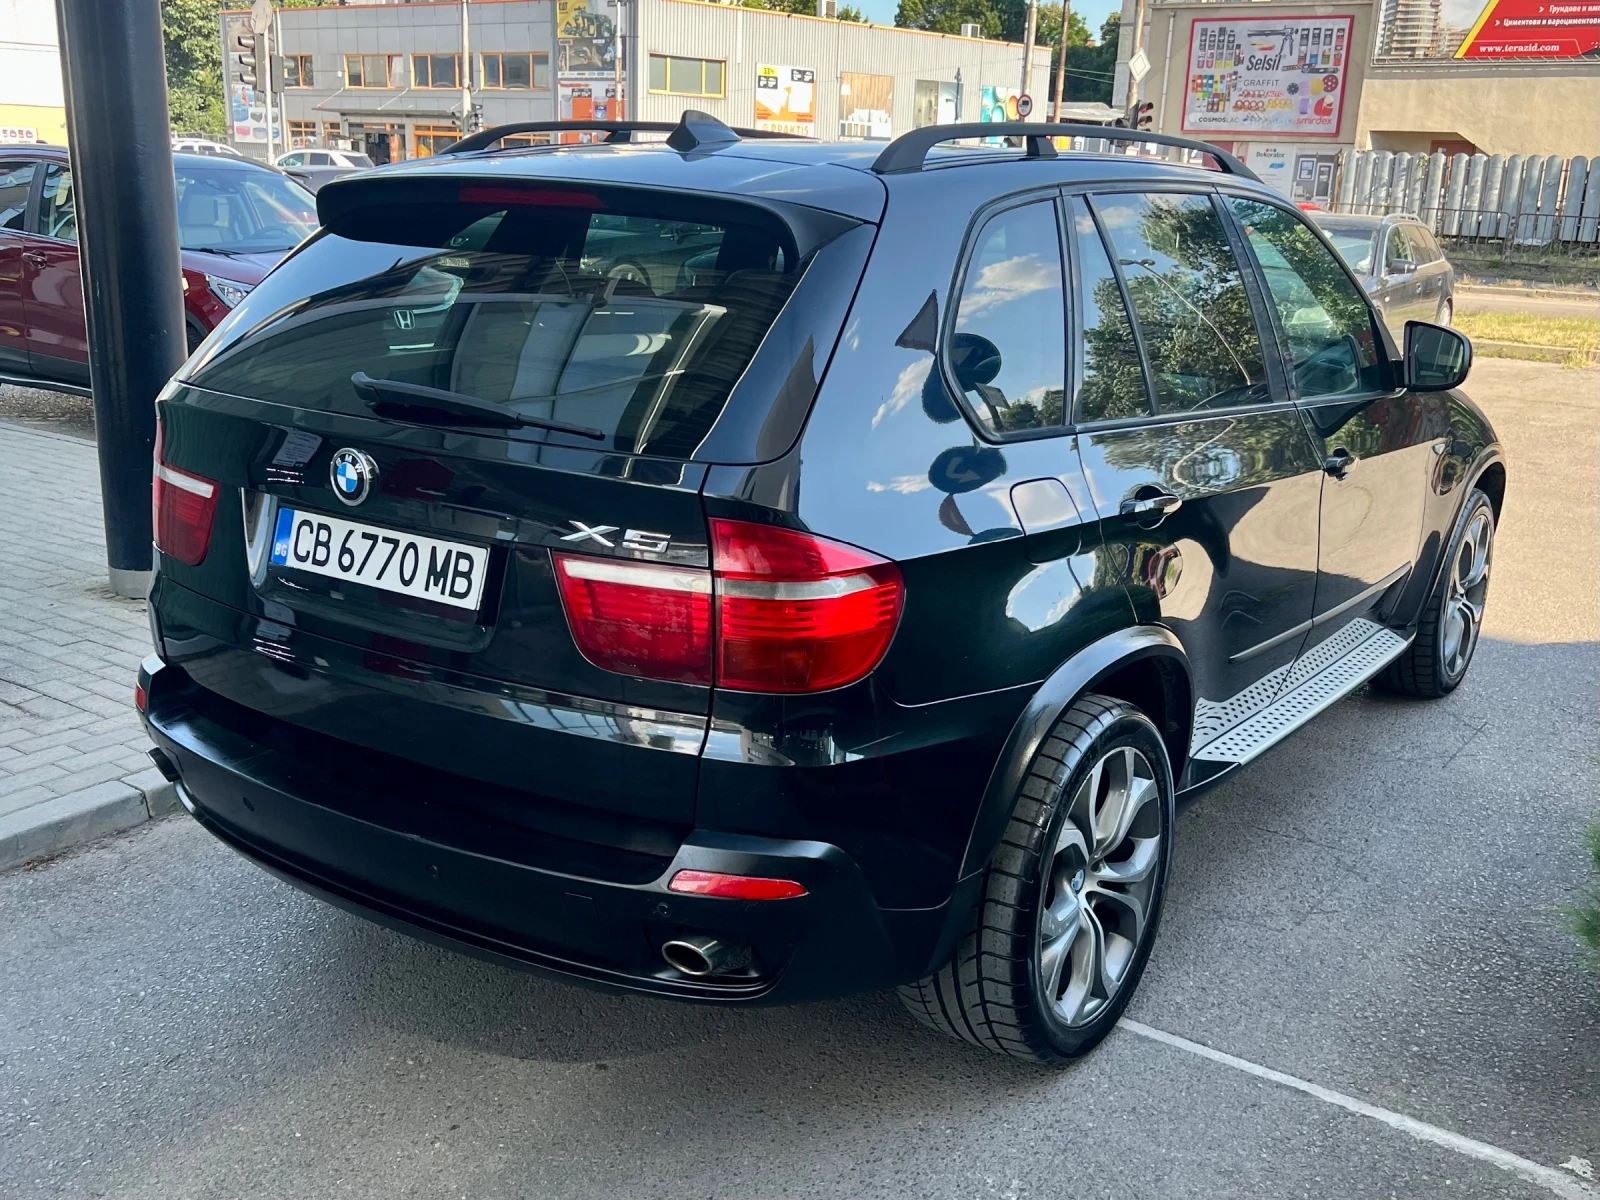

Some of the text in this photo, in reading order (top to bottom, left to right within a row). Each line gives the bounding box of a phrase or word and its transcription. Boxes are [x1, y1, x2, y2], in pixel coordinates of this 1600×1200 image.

[1549, 4, 1581, 14] Грундове
[1503, 18, 1541, 27] Циментови
[1479, 43, 1560, 53] www.terazid.com
[1246, 53, 1283, 71] Selsil
[1243, 79, 1280, 87] GRAFFIT
[1296, 117, 1332, 125] smirdex
[335, 454, 364, 473] BMW
[560, 520, 672, 554] X5
[274, 543, 287, 557] BG
[293, 519, 475, 600] CB 6770 MB
